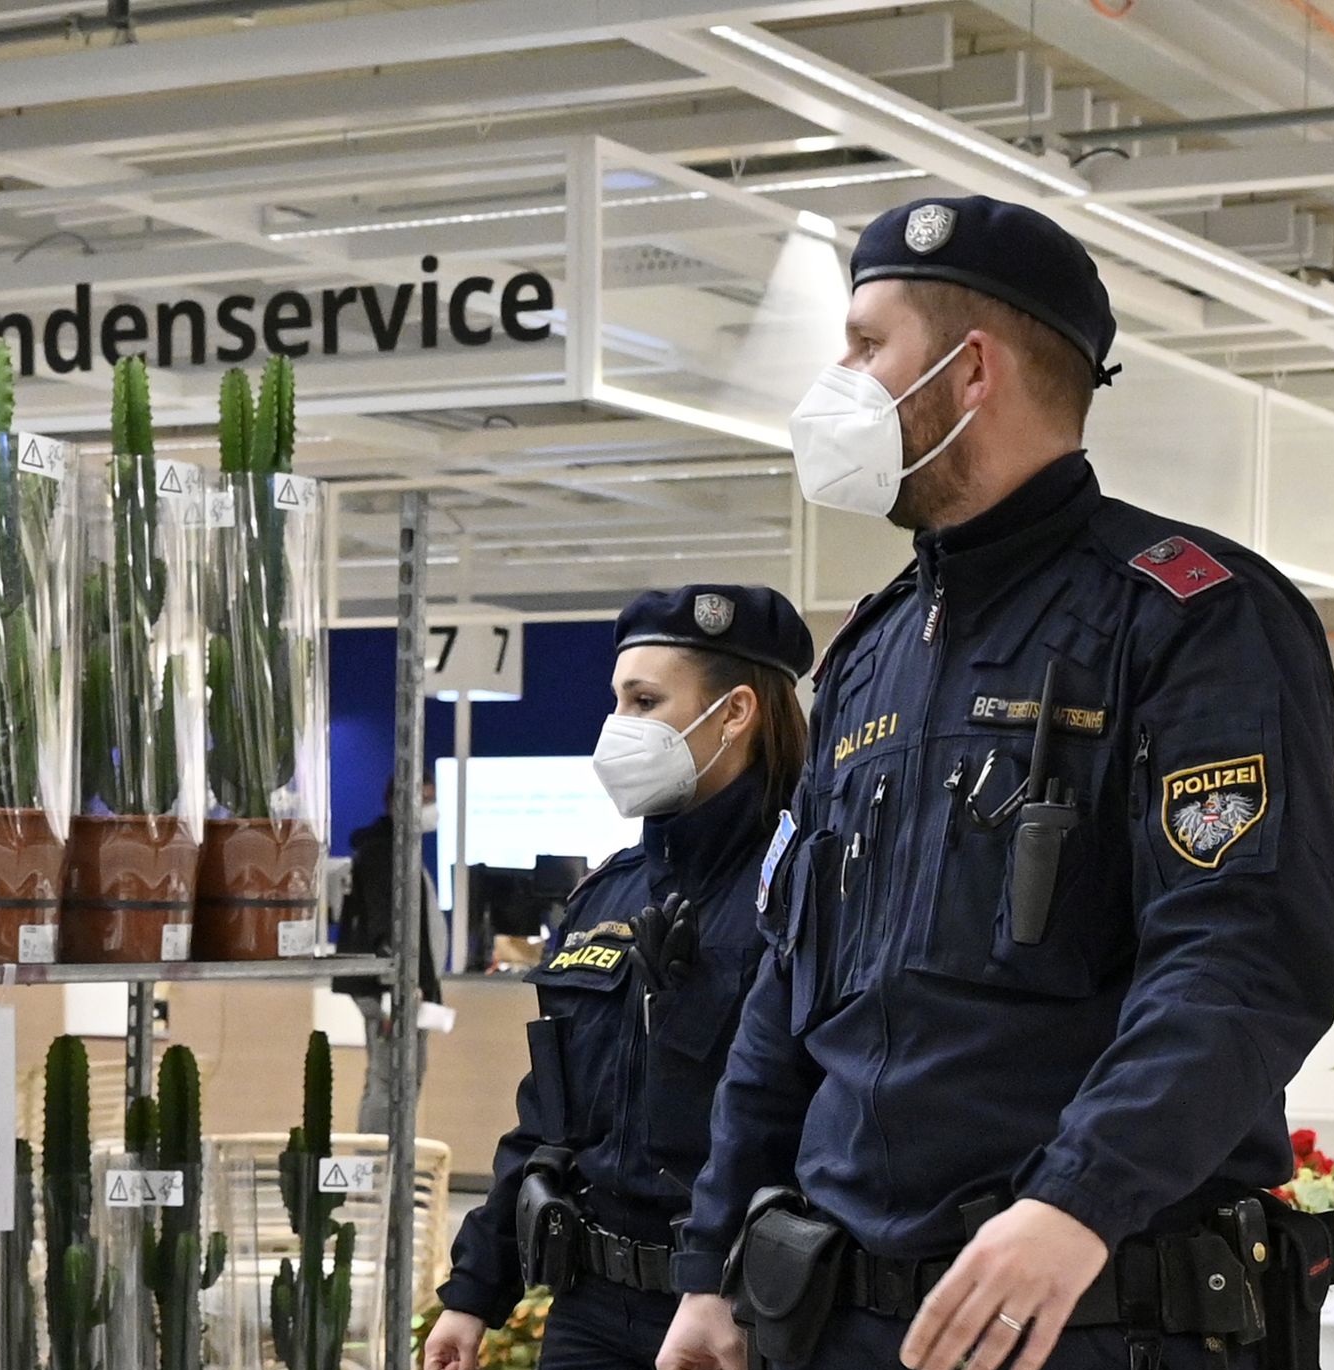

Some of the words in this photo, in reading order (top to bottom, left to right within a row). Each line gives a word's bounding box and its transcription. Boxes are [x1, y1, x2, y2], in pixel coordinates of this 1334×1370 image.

[922, 604, 939, 642] POLIZEI
[429, 626, 458, 673] 7
[493, 626, 509, 673] 7
[972, 696, 999, 718] BE
[833, 712, 899, 769] POLIZEI
[1171, 765, 1257, 800] POLIZEI
